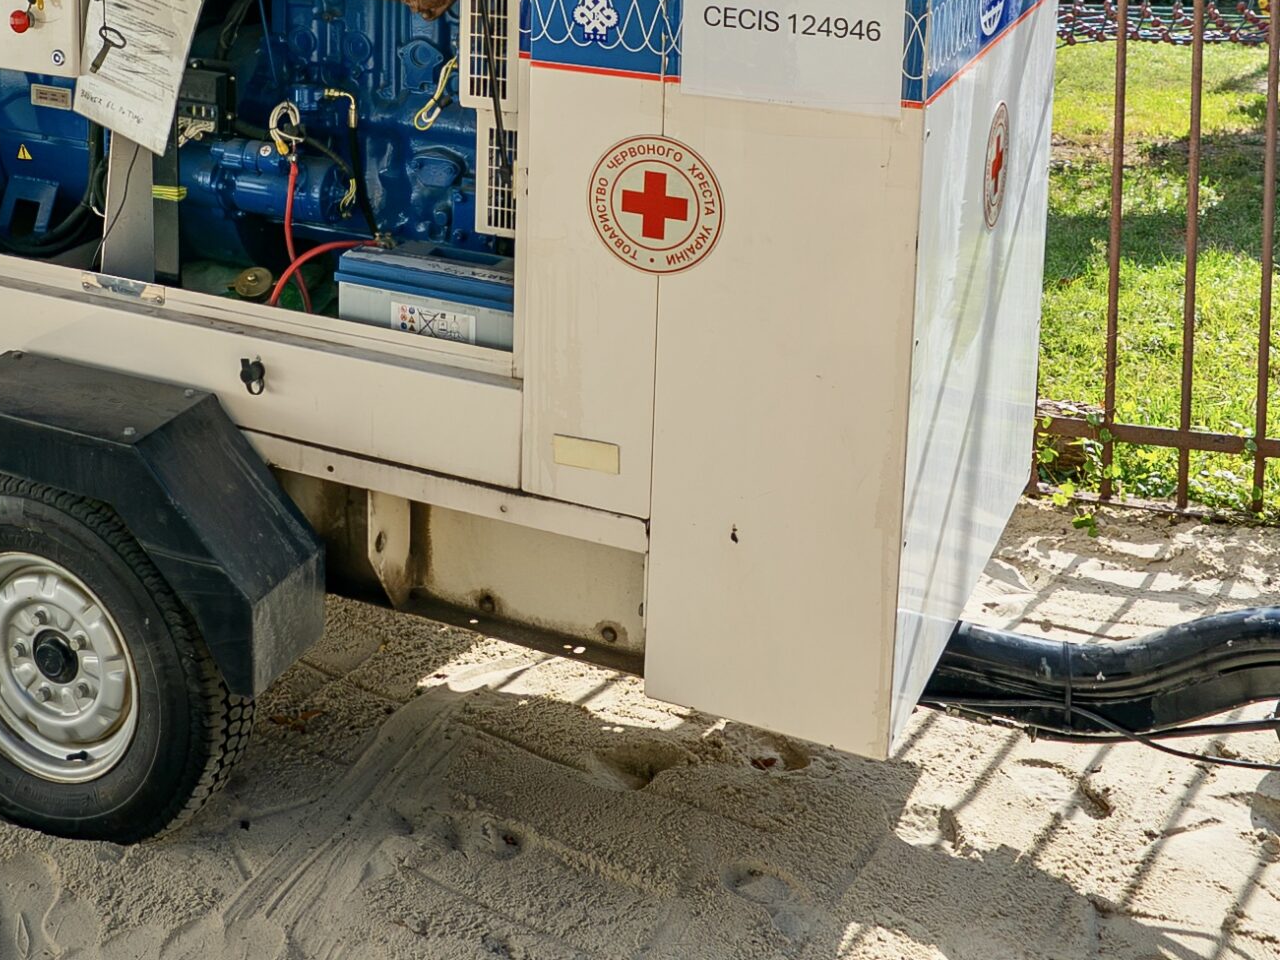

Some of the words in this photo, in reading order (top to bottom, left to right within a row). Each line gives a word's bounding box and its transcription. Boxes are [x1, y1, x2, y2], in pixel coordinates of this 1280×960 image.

[703, 5, 780, 32] CECIS
[787, 13, 881, 41] 124946
[606, 144, 684, 170] ЧЕРВОНОГО
[688, 163, 715, 216] ХРЕСТА
[596, 177, 638, 260] ТОВАРИСТВО
[665, 225, 713, 266] УКРАЇНИ
